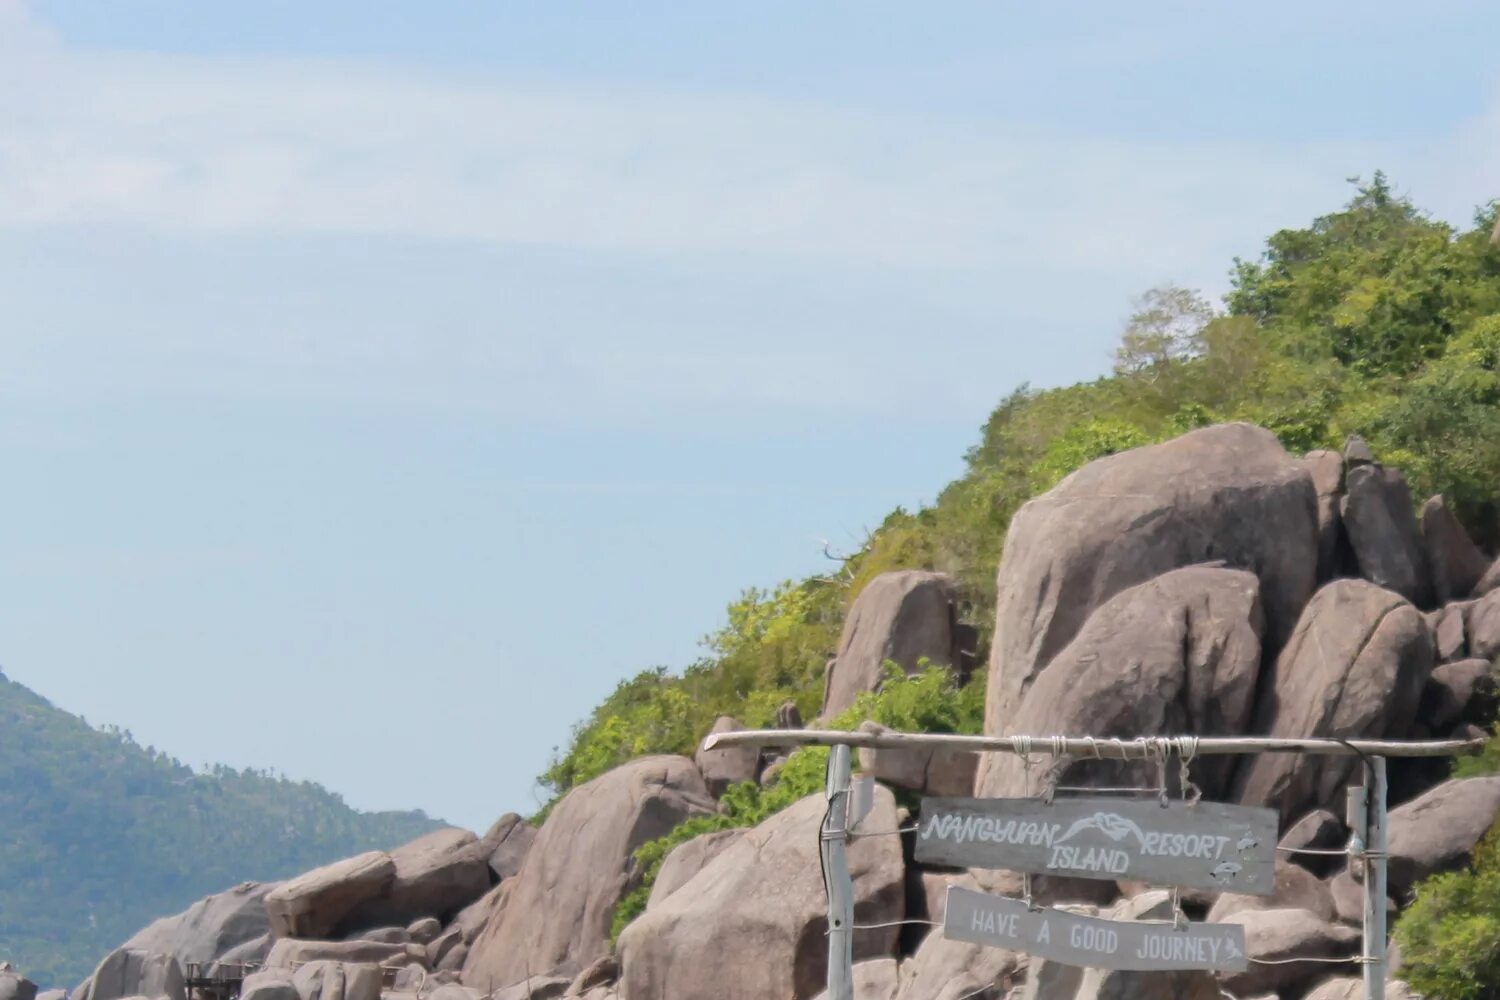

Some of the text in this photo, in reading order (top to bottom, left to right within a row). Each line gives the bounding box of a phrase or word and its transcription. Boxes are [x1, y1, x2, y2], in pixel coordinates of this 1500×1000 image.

[921, 814, 1230, 860] NANGYUAN RESORT
[1046, 845, 1129, 874] ISLAND
[971, 909, 1222, 963] HAVE A GOOD JOURNEY
